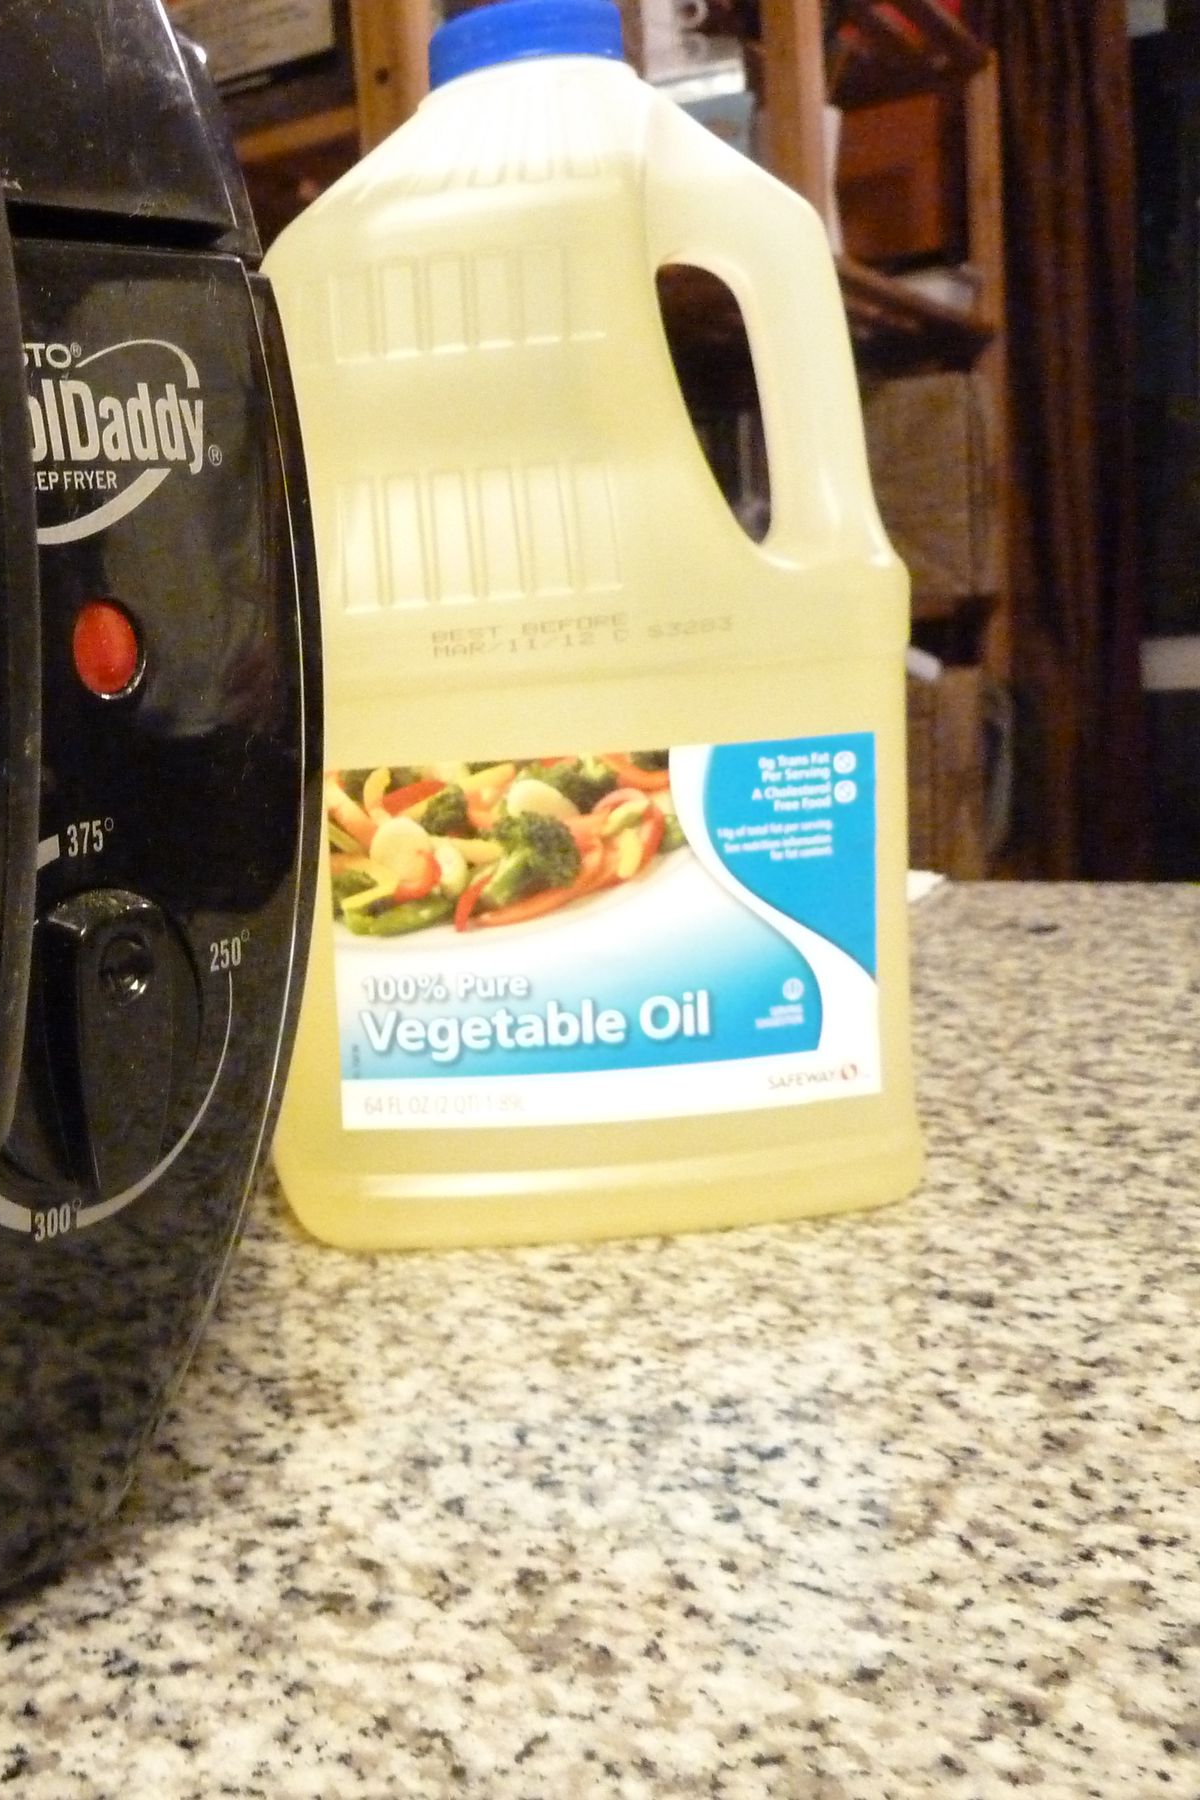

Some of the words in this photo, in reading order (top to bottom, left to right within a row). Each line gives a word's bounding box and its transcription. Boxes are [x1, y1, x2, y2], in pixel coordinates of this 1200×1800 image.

[63, 470, 118, 491] FRYER
[432, 625, 501, 644] BEST
[521, 613, 627, 635] BEFORE
[777, 754, 809, 768] Trans
[784, 766, 831, 781] Serving
[363, 973, 448, 1001] 100%
[457, 972, 530, 999] Pure
[359, 998, 628, 1063] Vegetable
[638, 988, 711, 1041] Oil
[767, 1069, 836, 1091] SAFEWAY
[363, 1095, 383, 1115] 64
[387, 1095, 403, 1115] FL
[408, 1095, 429, 1115] OZ
